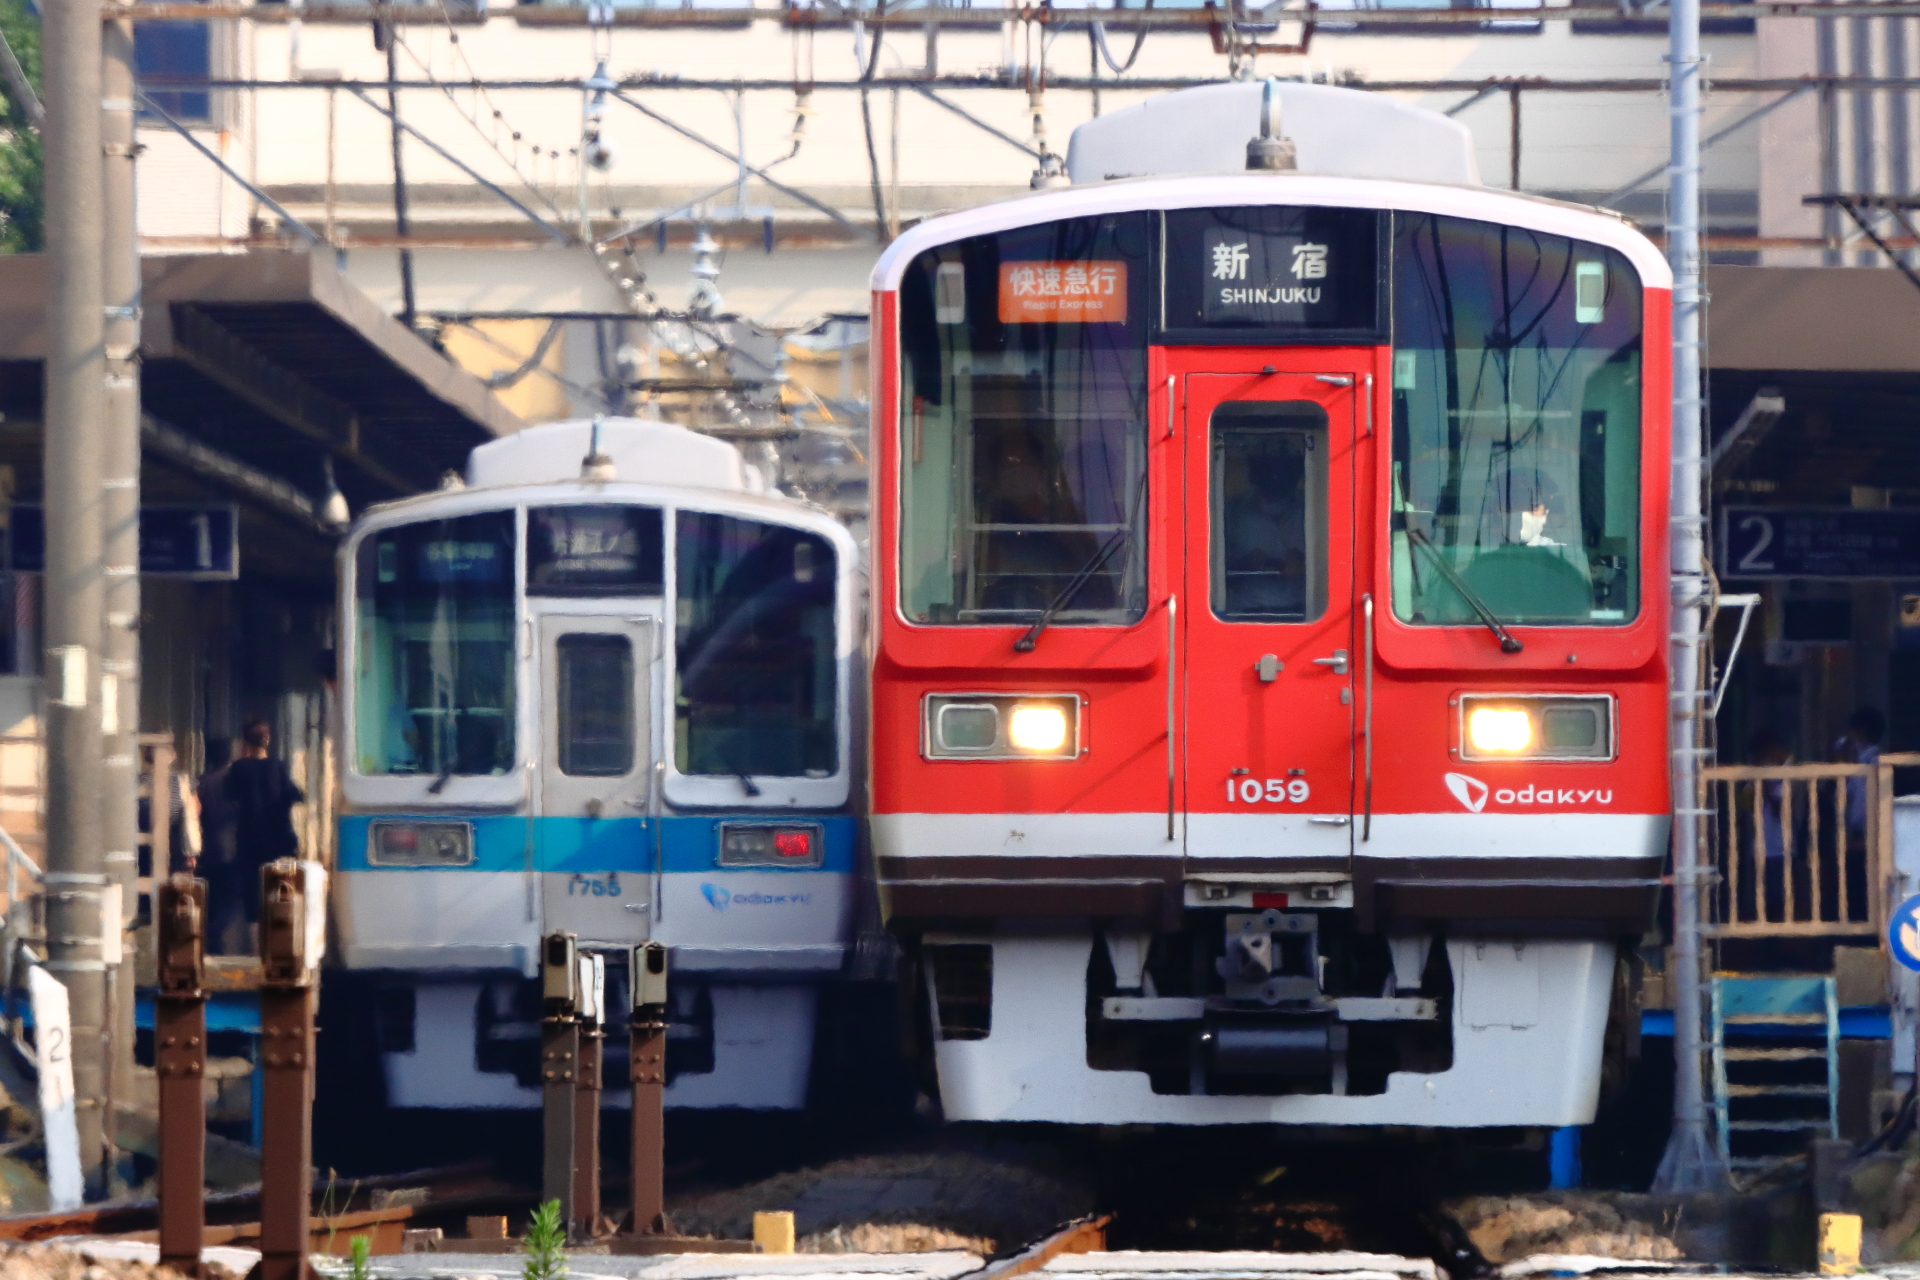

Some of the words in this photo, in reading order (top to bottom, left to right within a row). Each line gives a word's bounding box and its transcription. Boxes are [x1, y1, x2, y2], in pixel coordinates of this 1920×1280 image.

[1213, 243, 1330, 280] 新宿
[1010, 266, 1117, 297] 快速急行
[1059, 299, 1104, 310] Express
[1219, 287, 1322, 303] SHINJUKU
[192, 513, 213, 568] 1
[1739, 515, 1775, 570] 2
[1226, 779, 1311, 804] 1059
[1494, 784, 1612, 805] odakyu
[567, 879, 622, 897] 1755
